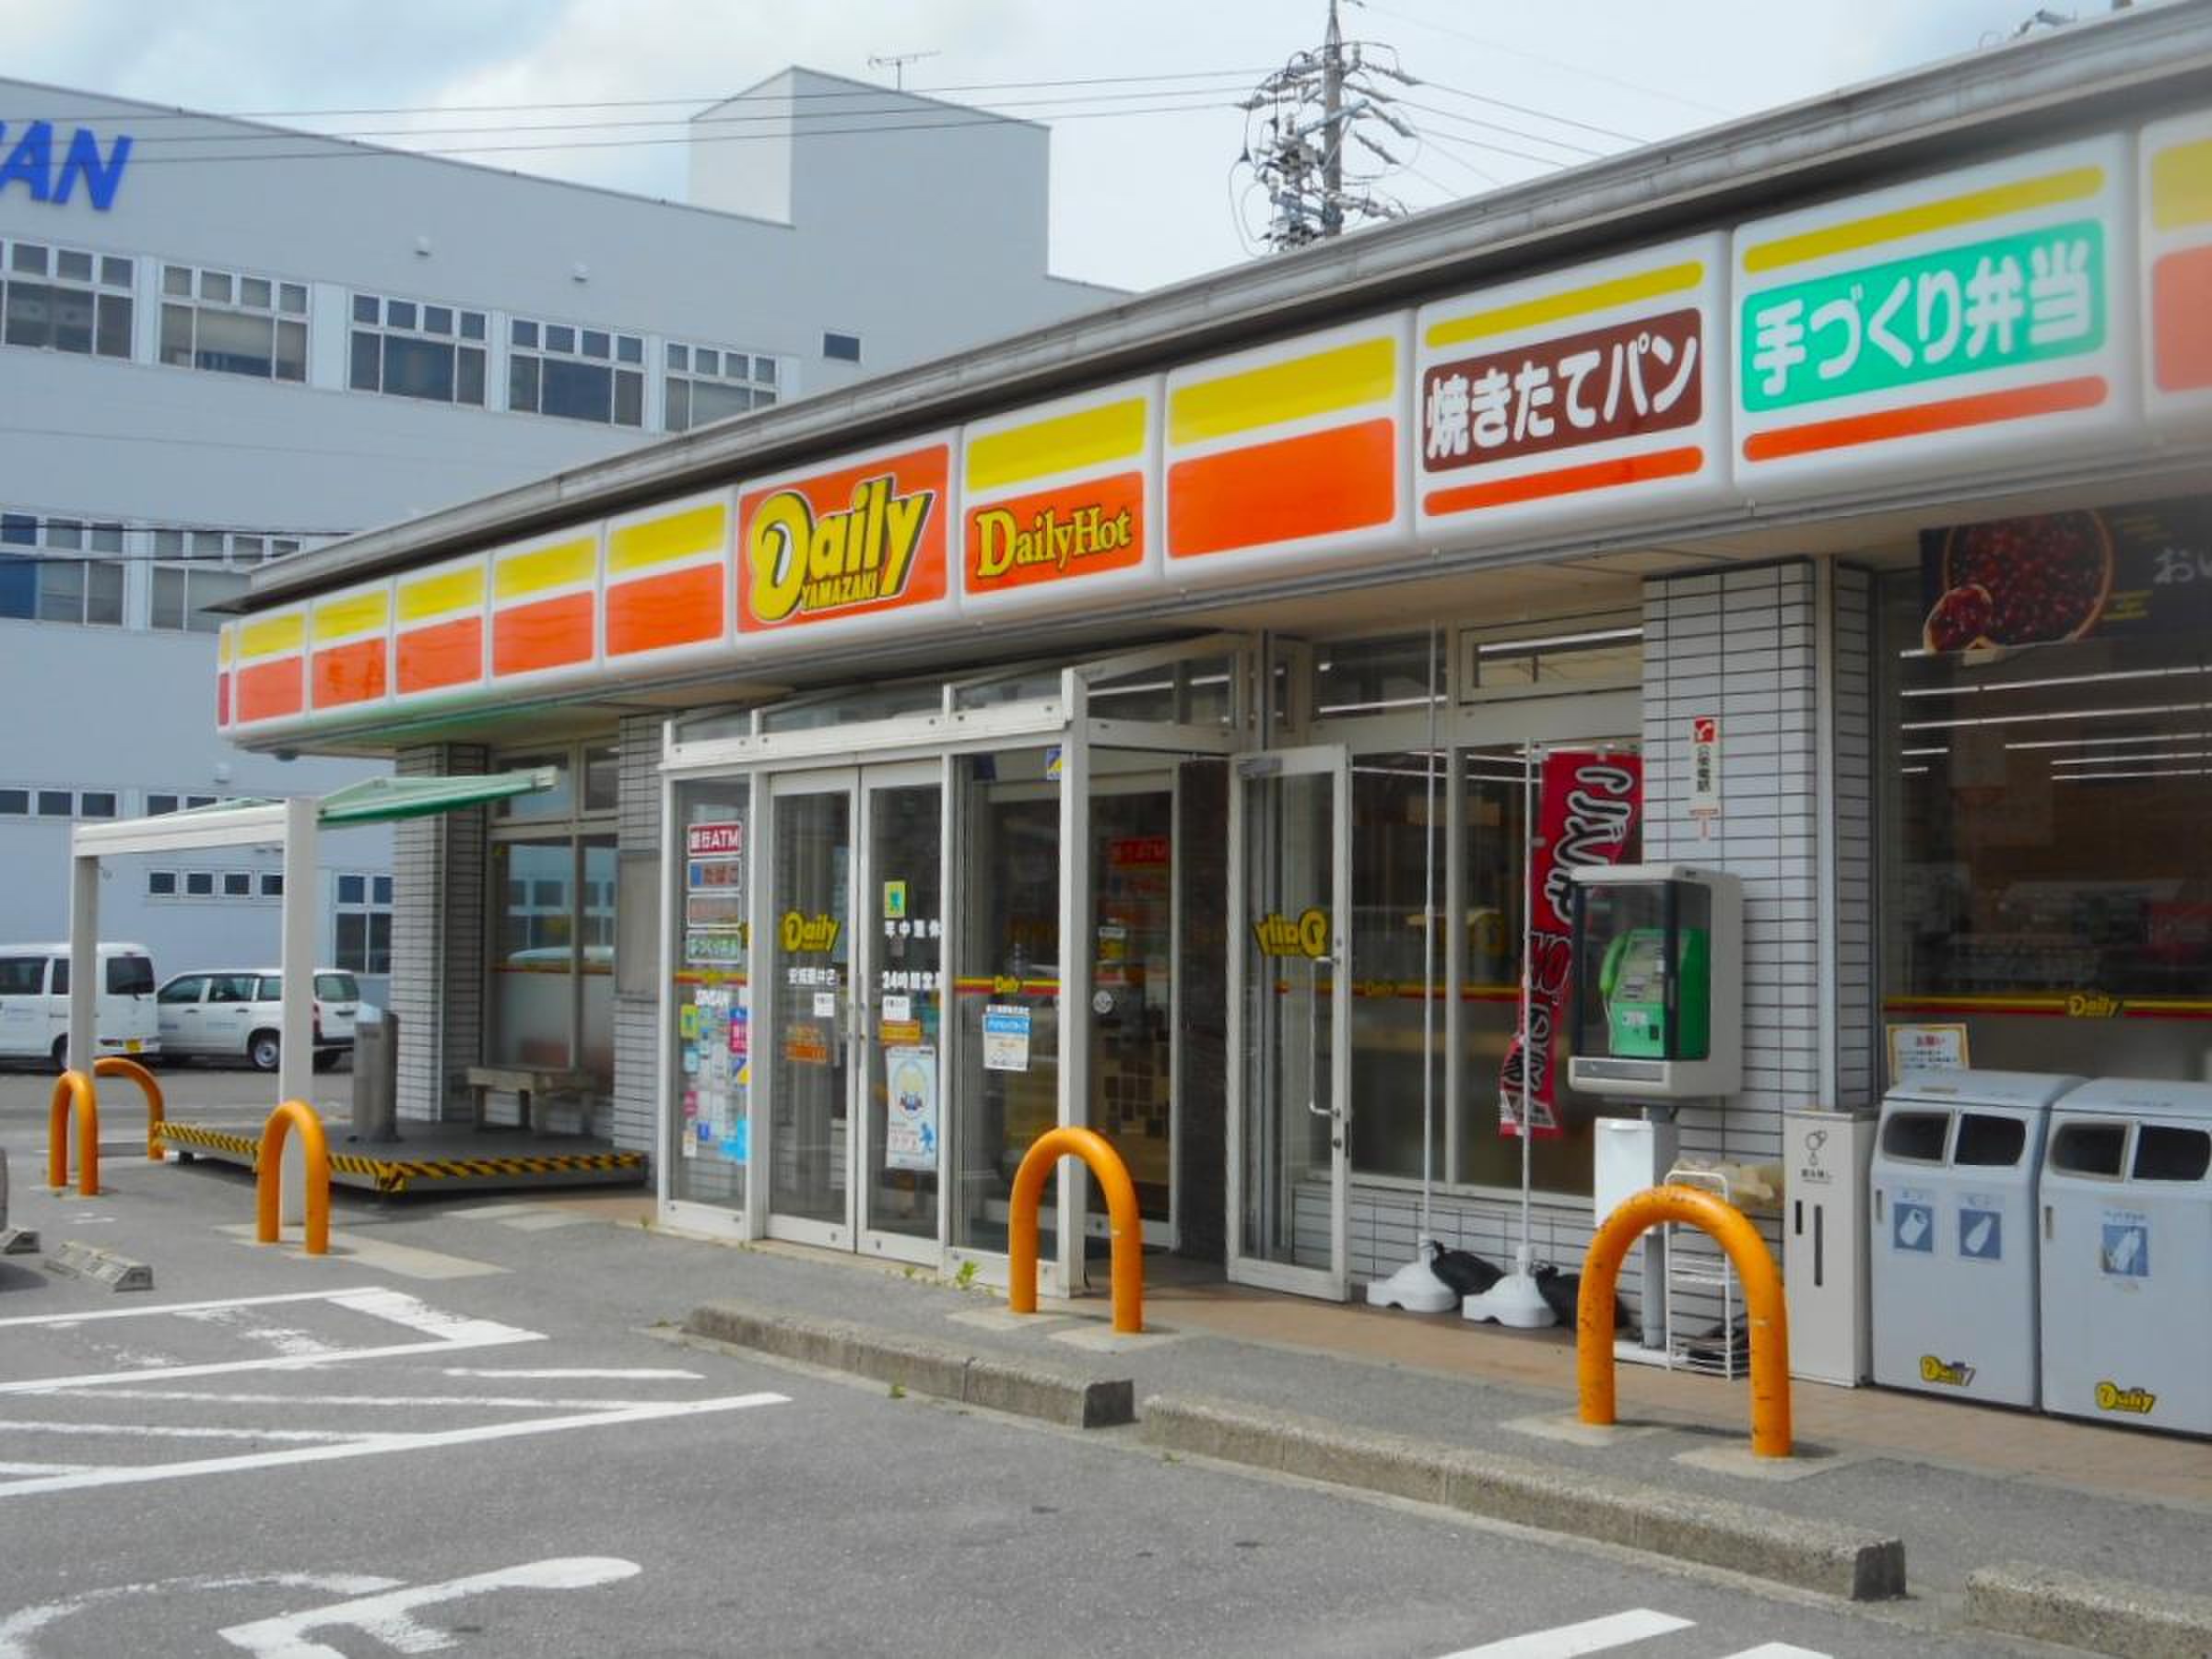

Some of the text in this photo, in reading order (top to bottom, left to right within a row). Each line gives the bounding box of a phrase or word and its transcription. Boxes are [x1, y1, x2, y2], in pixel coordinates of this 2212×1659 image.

[0, 119, 134, 212] AN
[1751, 238, 2092, 398] 手づくり弁当
[1426, 331, 1699, 461] 焼きたてパン
[751, 474, 934, 624] Daily
[976, 504, 1132, 578] DailyHot
[803, 570, 882, 610] YAMAZAKI
[782, 911, 840, 953] Daily
[2066, 993, 2121, 1018] Daily
